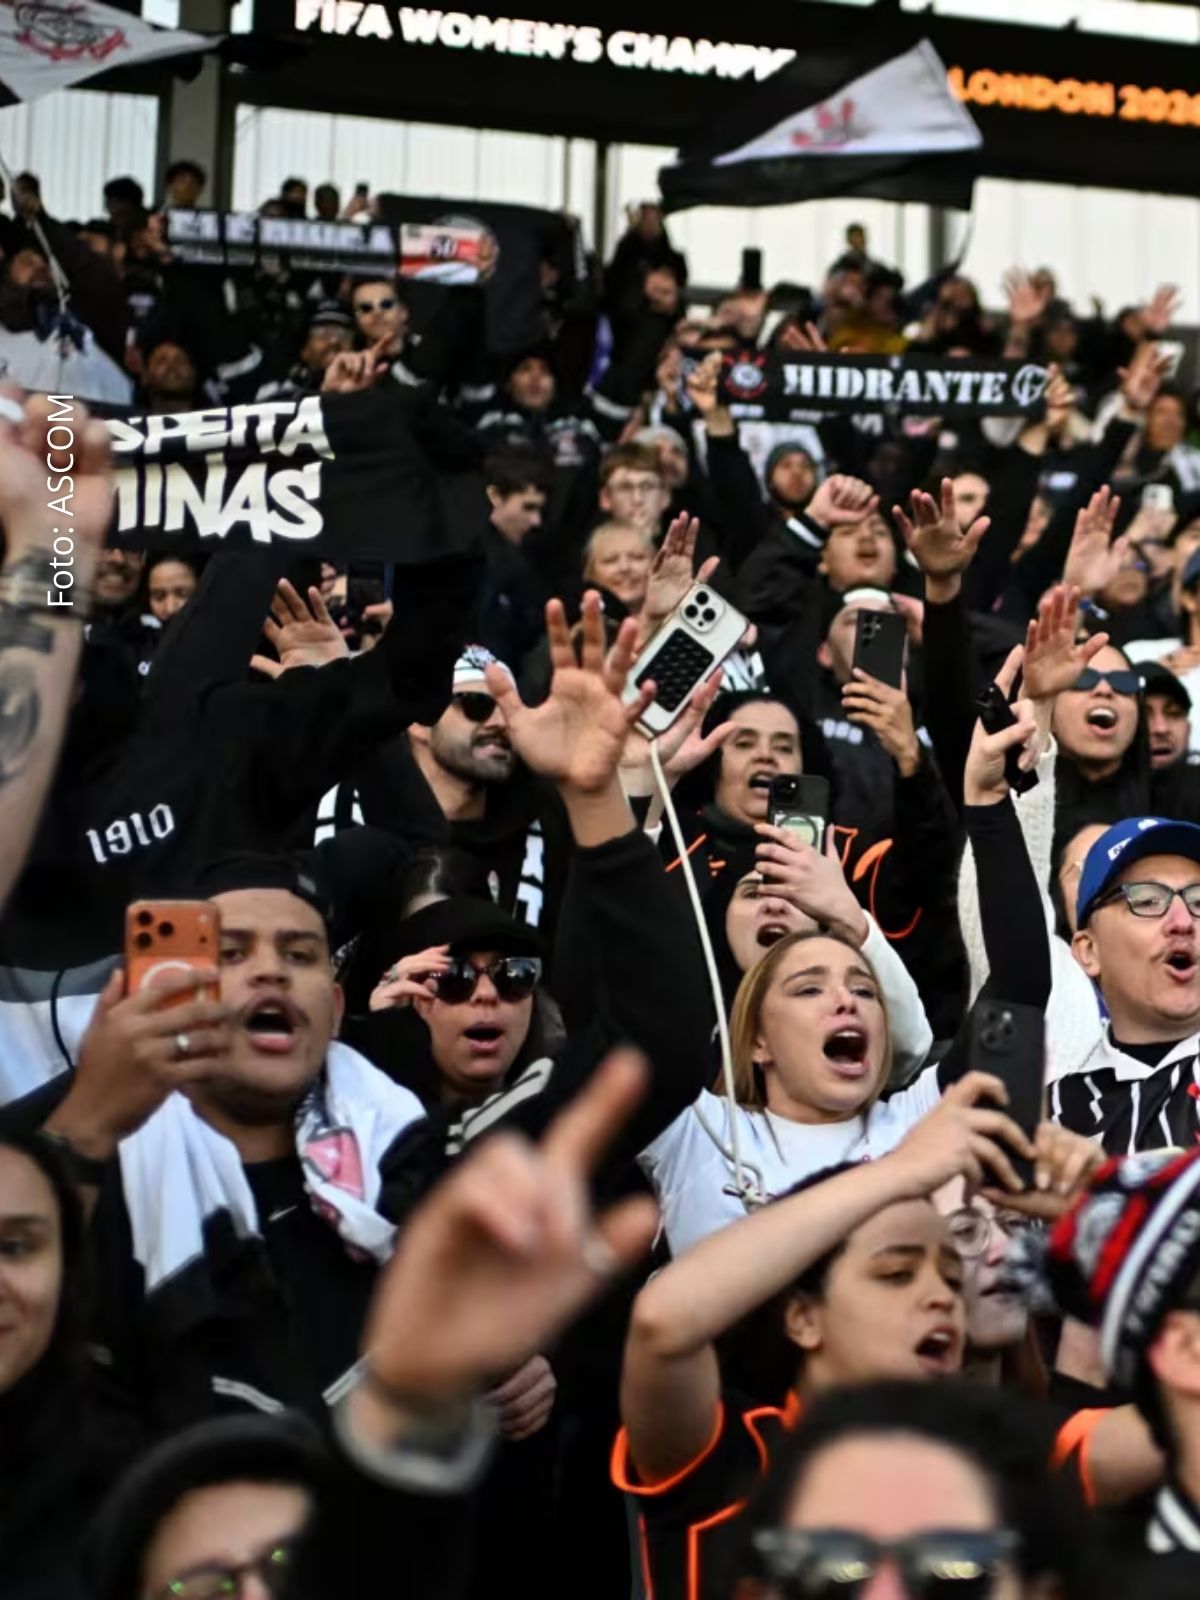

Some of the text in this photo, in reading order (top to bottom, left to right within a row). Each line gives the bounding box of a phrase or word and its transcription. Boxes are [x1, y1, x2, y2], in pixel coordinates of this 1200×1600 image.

[295, 0, 394, 40] FIFA
[399, 6, 602, 64] WOMEN'S
[946, 65, 1115, 118] LONDON
[86, 802, 175, 863] 1910
